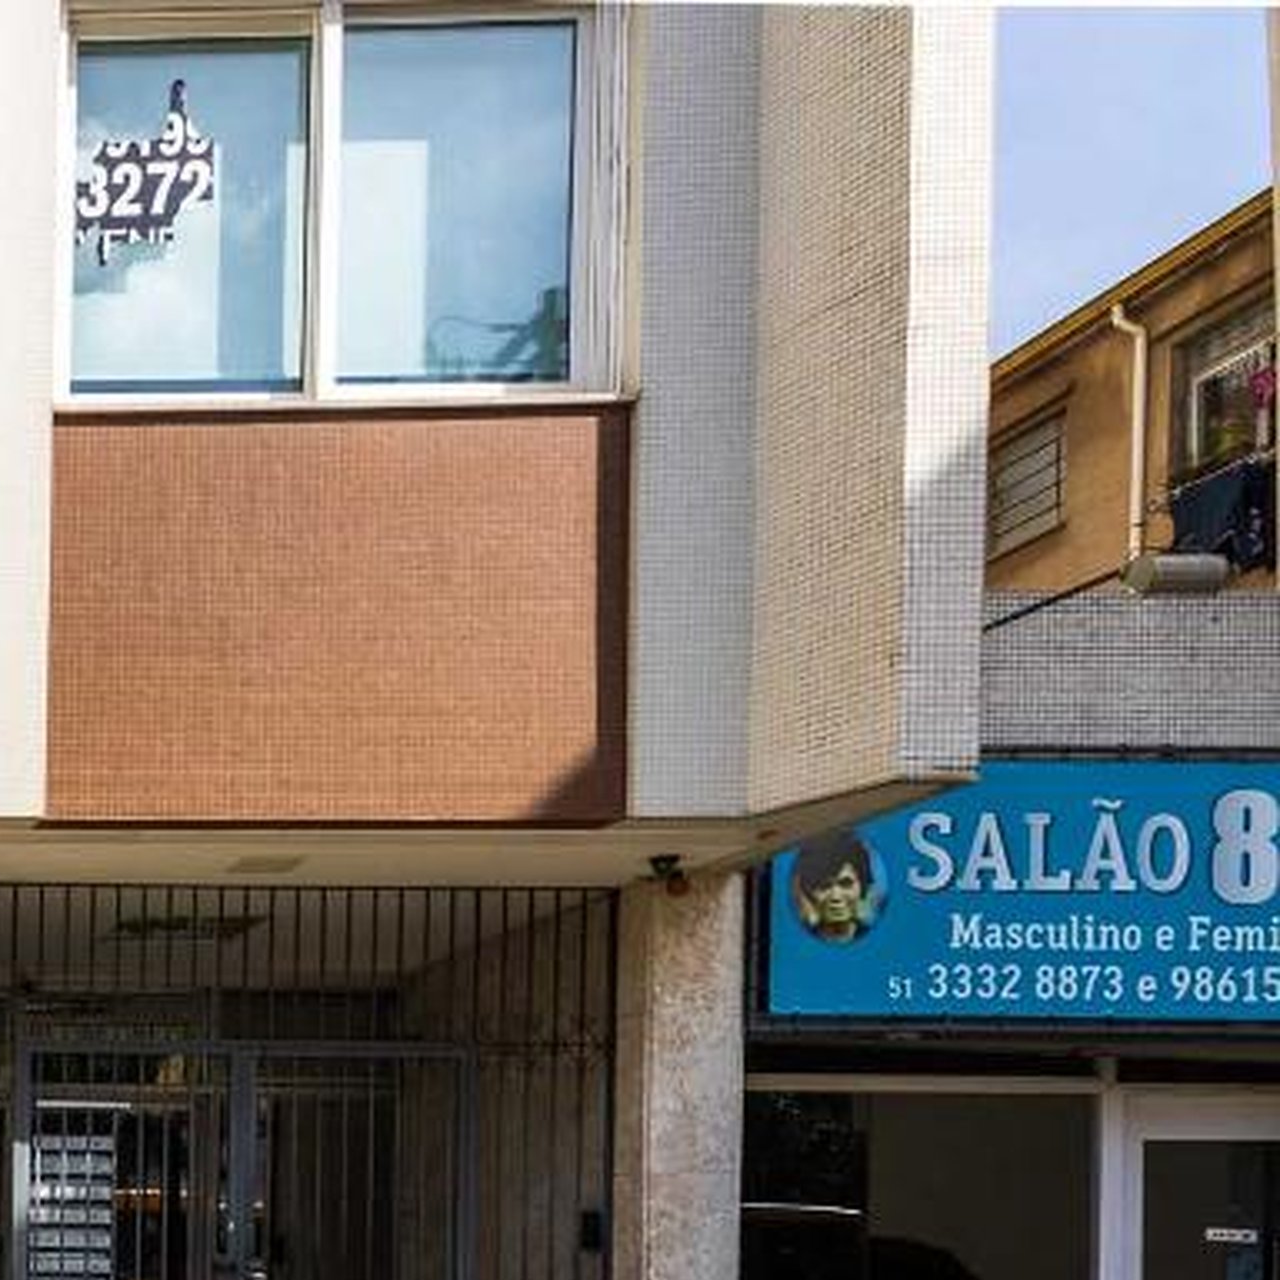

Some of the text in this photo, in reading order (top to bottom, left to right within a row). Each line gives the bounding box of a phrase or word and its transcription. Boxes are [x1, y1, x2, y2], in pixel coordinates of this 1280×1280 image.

[77, 160, 211, 217] 3272
[907, 799, 1192, 892] SALÃO
[950, 914, 1280, 951] Masculino e Femi
[889, 965, 1280, 1002] 51 3332 8873 e 98615
